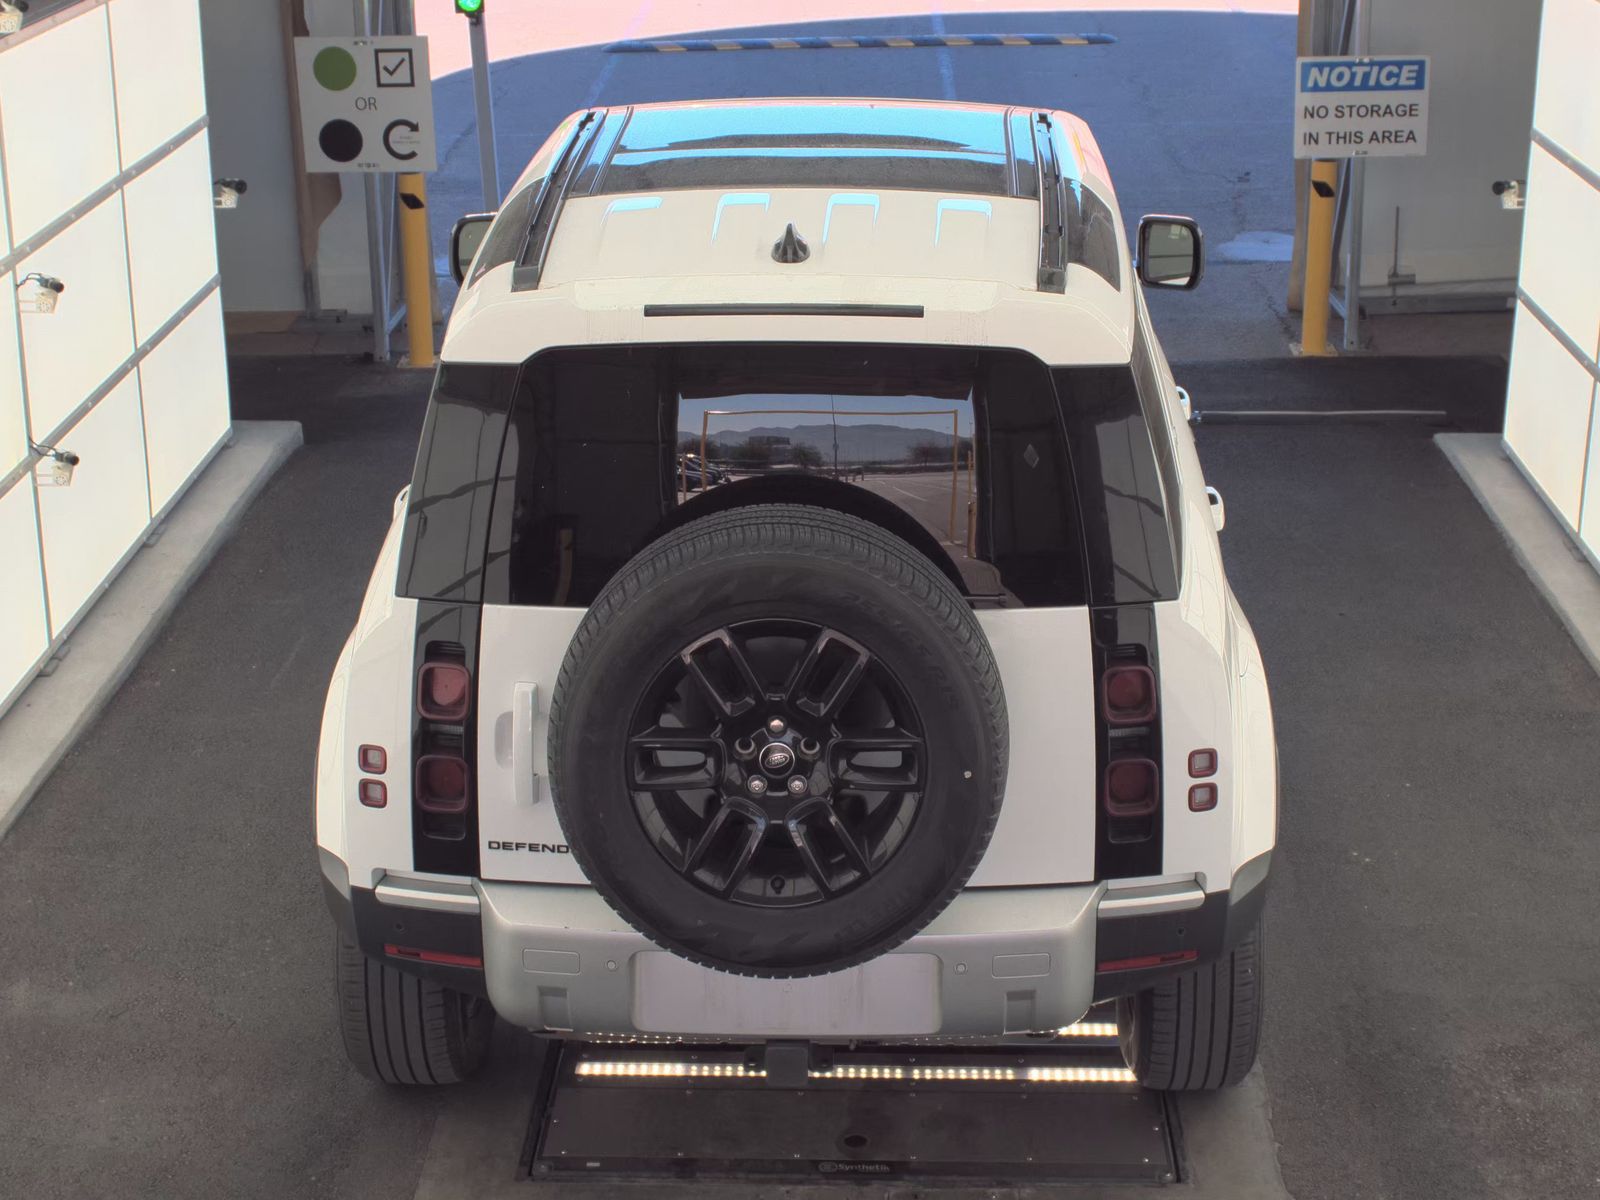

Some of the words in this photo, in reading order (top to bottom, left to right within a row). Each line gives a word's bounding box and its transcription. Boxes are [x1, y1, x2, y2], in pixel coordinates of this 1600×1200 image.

[1307, 65, 1419, 87] NOTICE
[355, 96, 378, 111] OR
[1304, 105, 1328, 119] NO
[1334, 103, 1419, 119] STORAGE
[1303, 132, 1319, 146] IN
[1325, 130, 1364, 145] THIS
[1368, 129, 1417, 144] AREA
[488, 840, 570, 854] DEFEND
